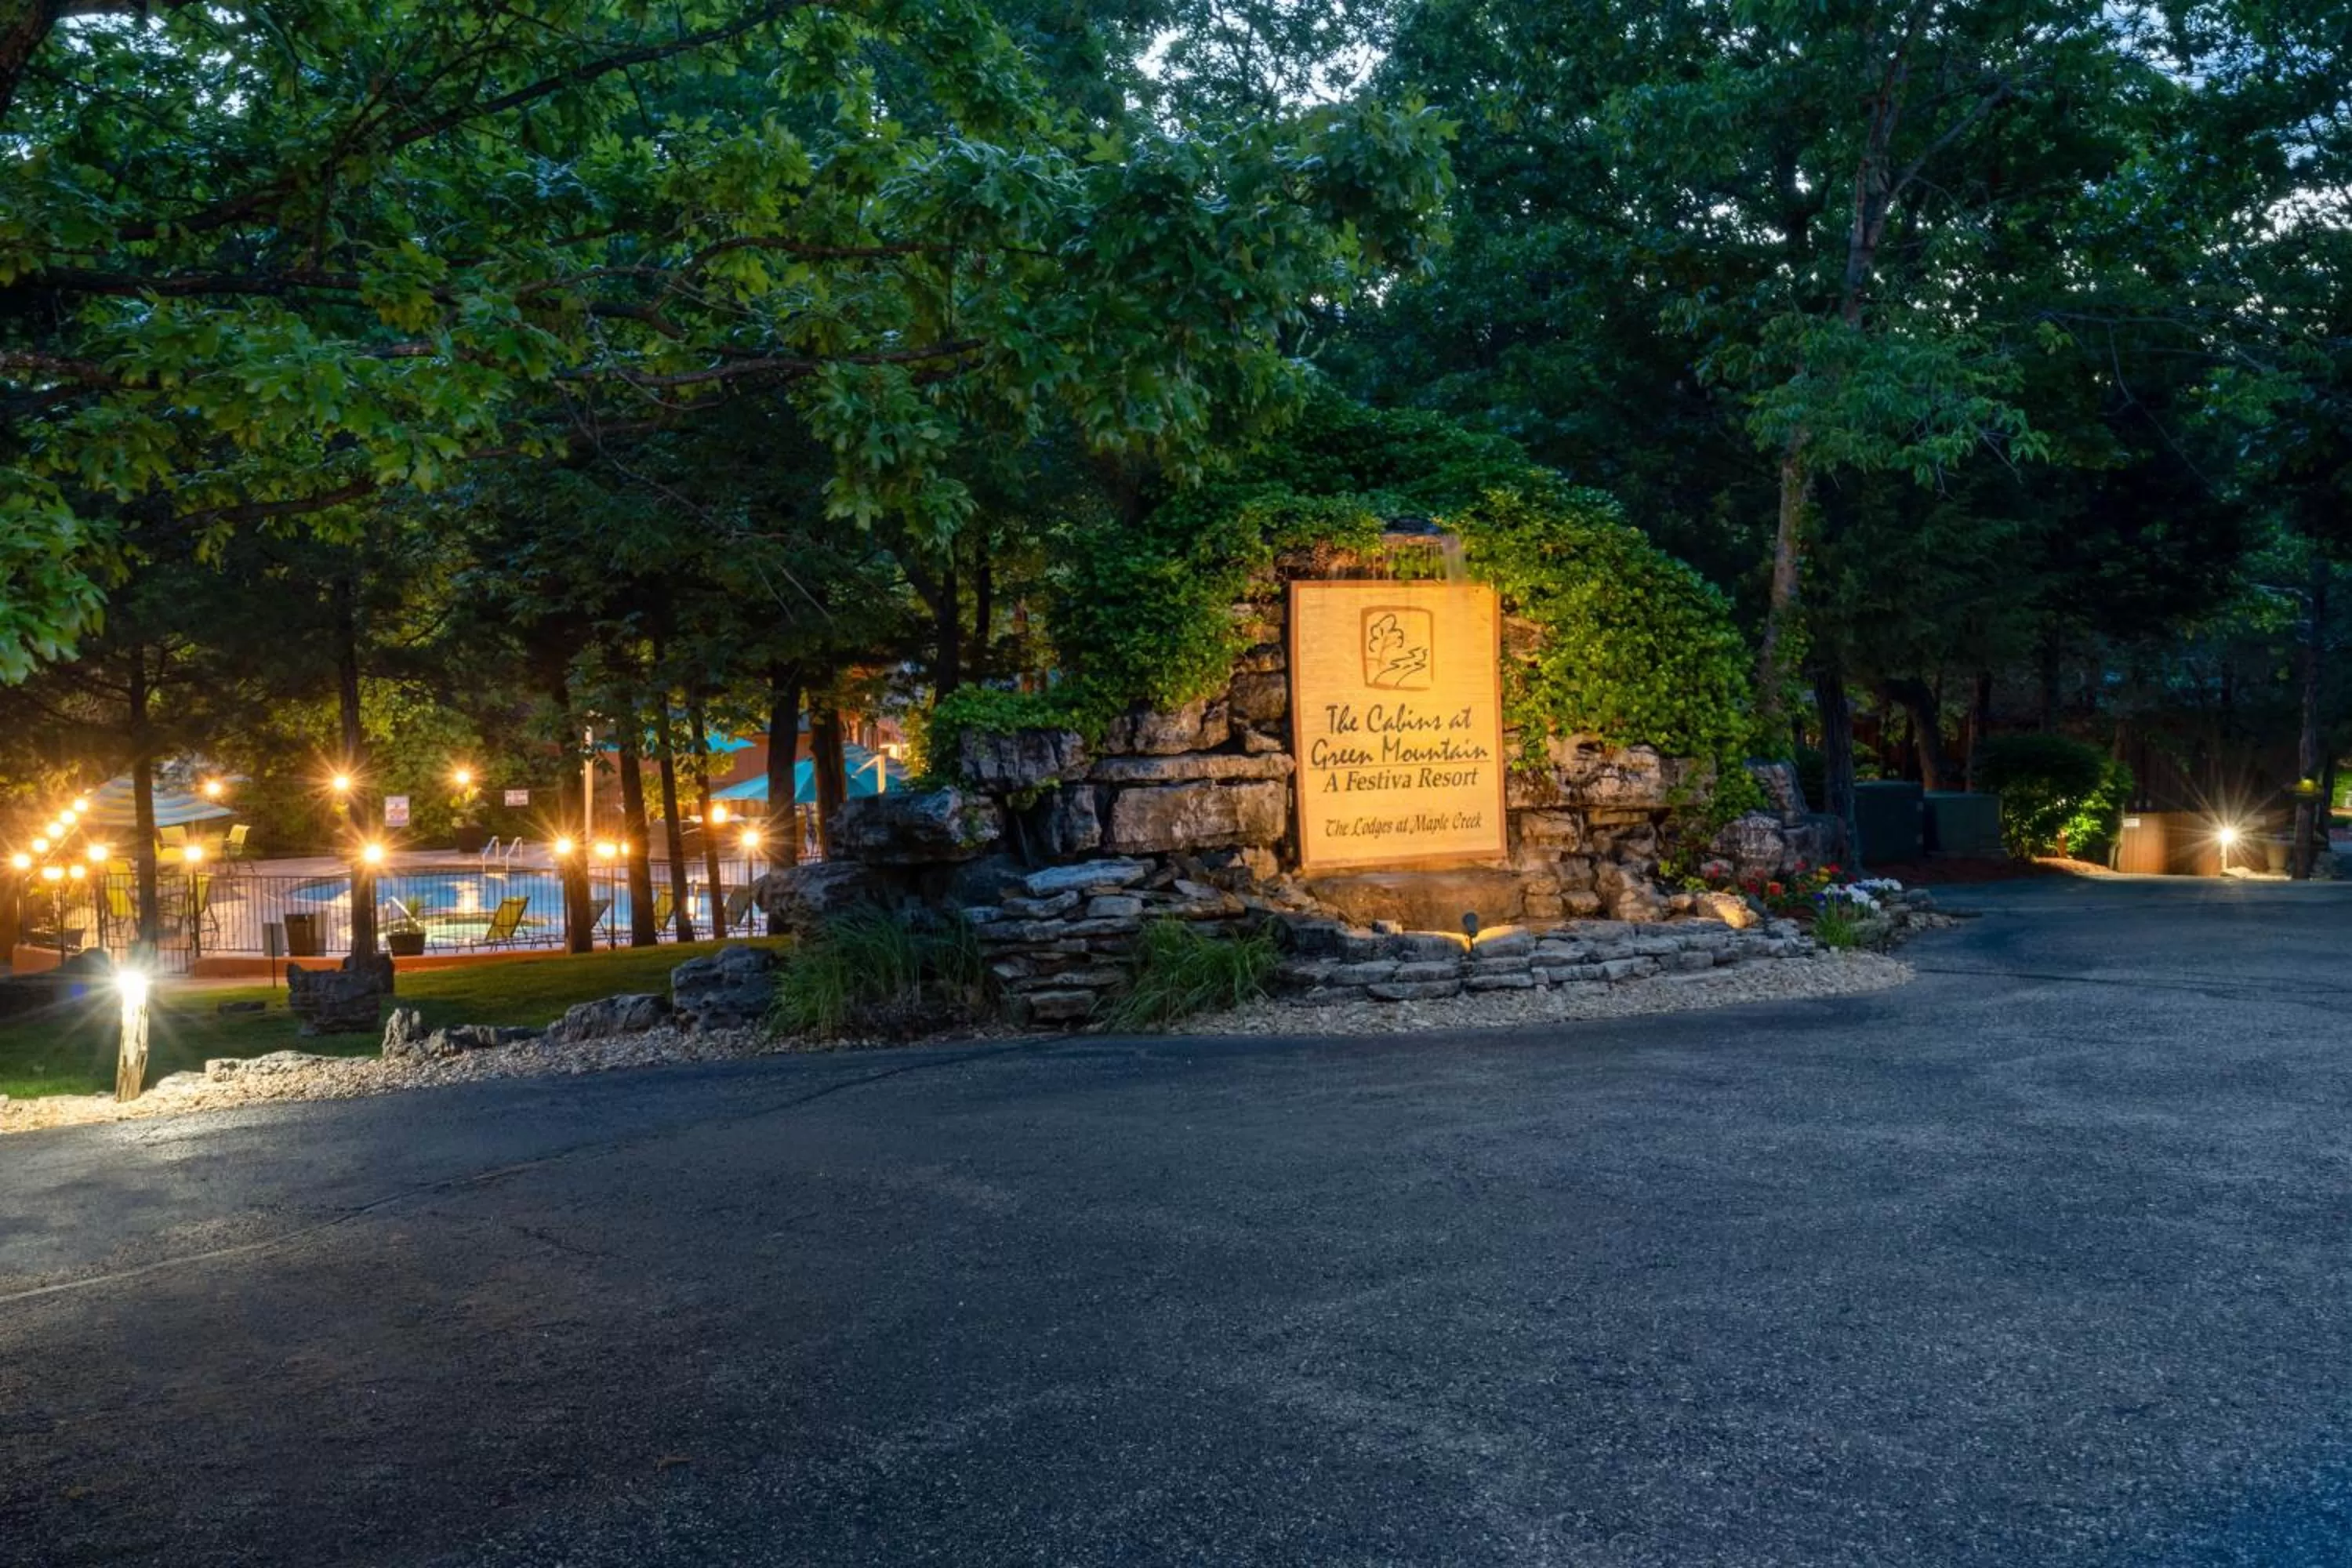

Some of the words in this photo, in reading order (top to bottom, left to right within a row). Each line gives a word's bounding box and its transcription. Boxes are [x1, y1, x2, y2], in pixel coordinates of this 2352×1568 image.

[1326, 705, 1358, 735] The
[1367, 703, 1443, 733] Cabins
[1449, 706, 1472, 730] at
[1311, 739, 1374, 770] Green
[1382, 735, 1488, 762] Mountain
[1323, 771, 1339, 793] A
[1345, 769, 1411, 791] Festiva
[1417, 767, 1479, 789] Resort
[1325, 818, 1348, 837] The
[1351, 817, 1393, 839] Lodges
[1396, 817, 1408, 833] at
[1410, 813, 1449, 835] Maple
[1452, 811, 1482, 829] Creek
